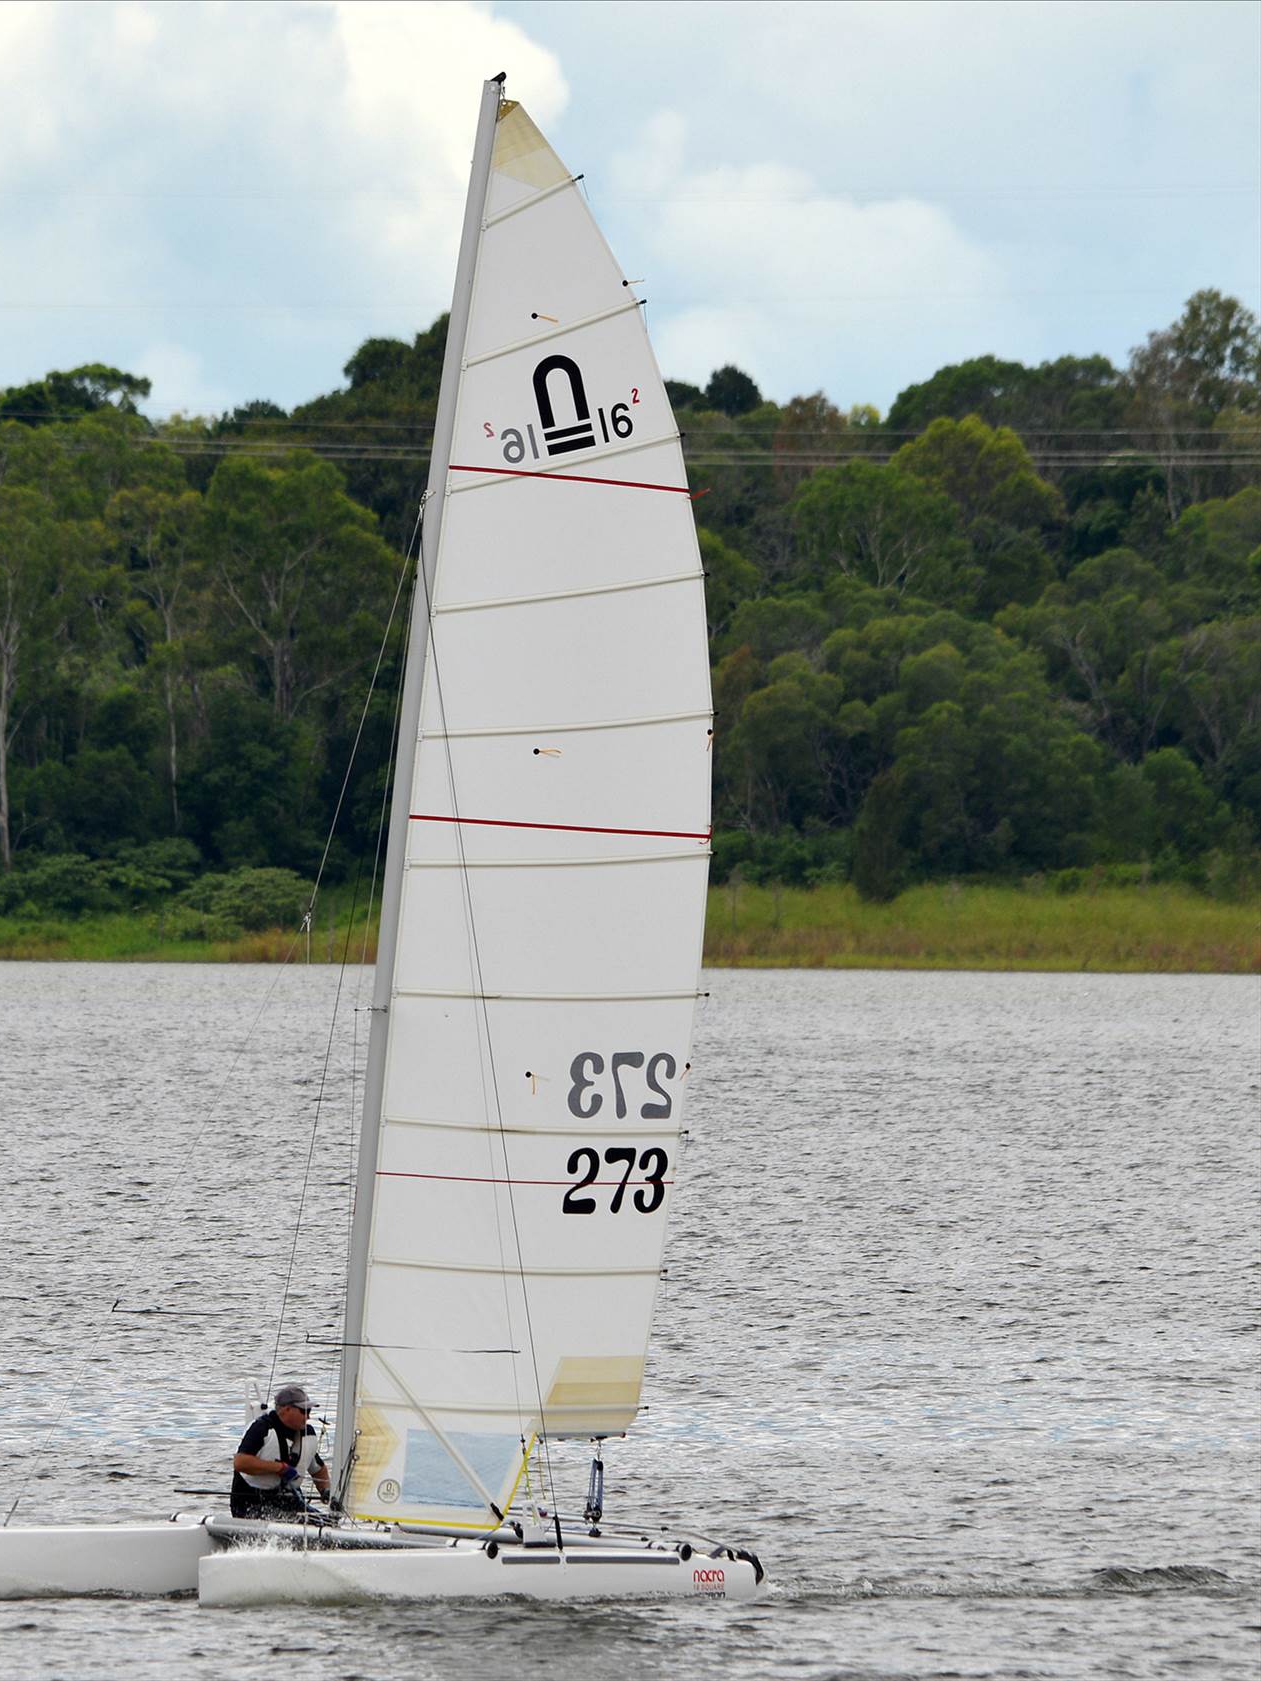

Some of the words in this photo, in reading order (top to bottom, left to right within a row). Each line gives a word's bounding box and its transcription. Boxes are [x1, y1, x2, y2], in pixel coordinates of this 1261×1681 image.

[597, 402, 634, 444] 16
[630, 387, 641, 405] 2
[562, 1147, 669, 1215] 273
[693, 1569, 725, 1582] nacra
